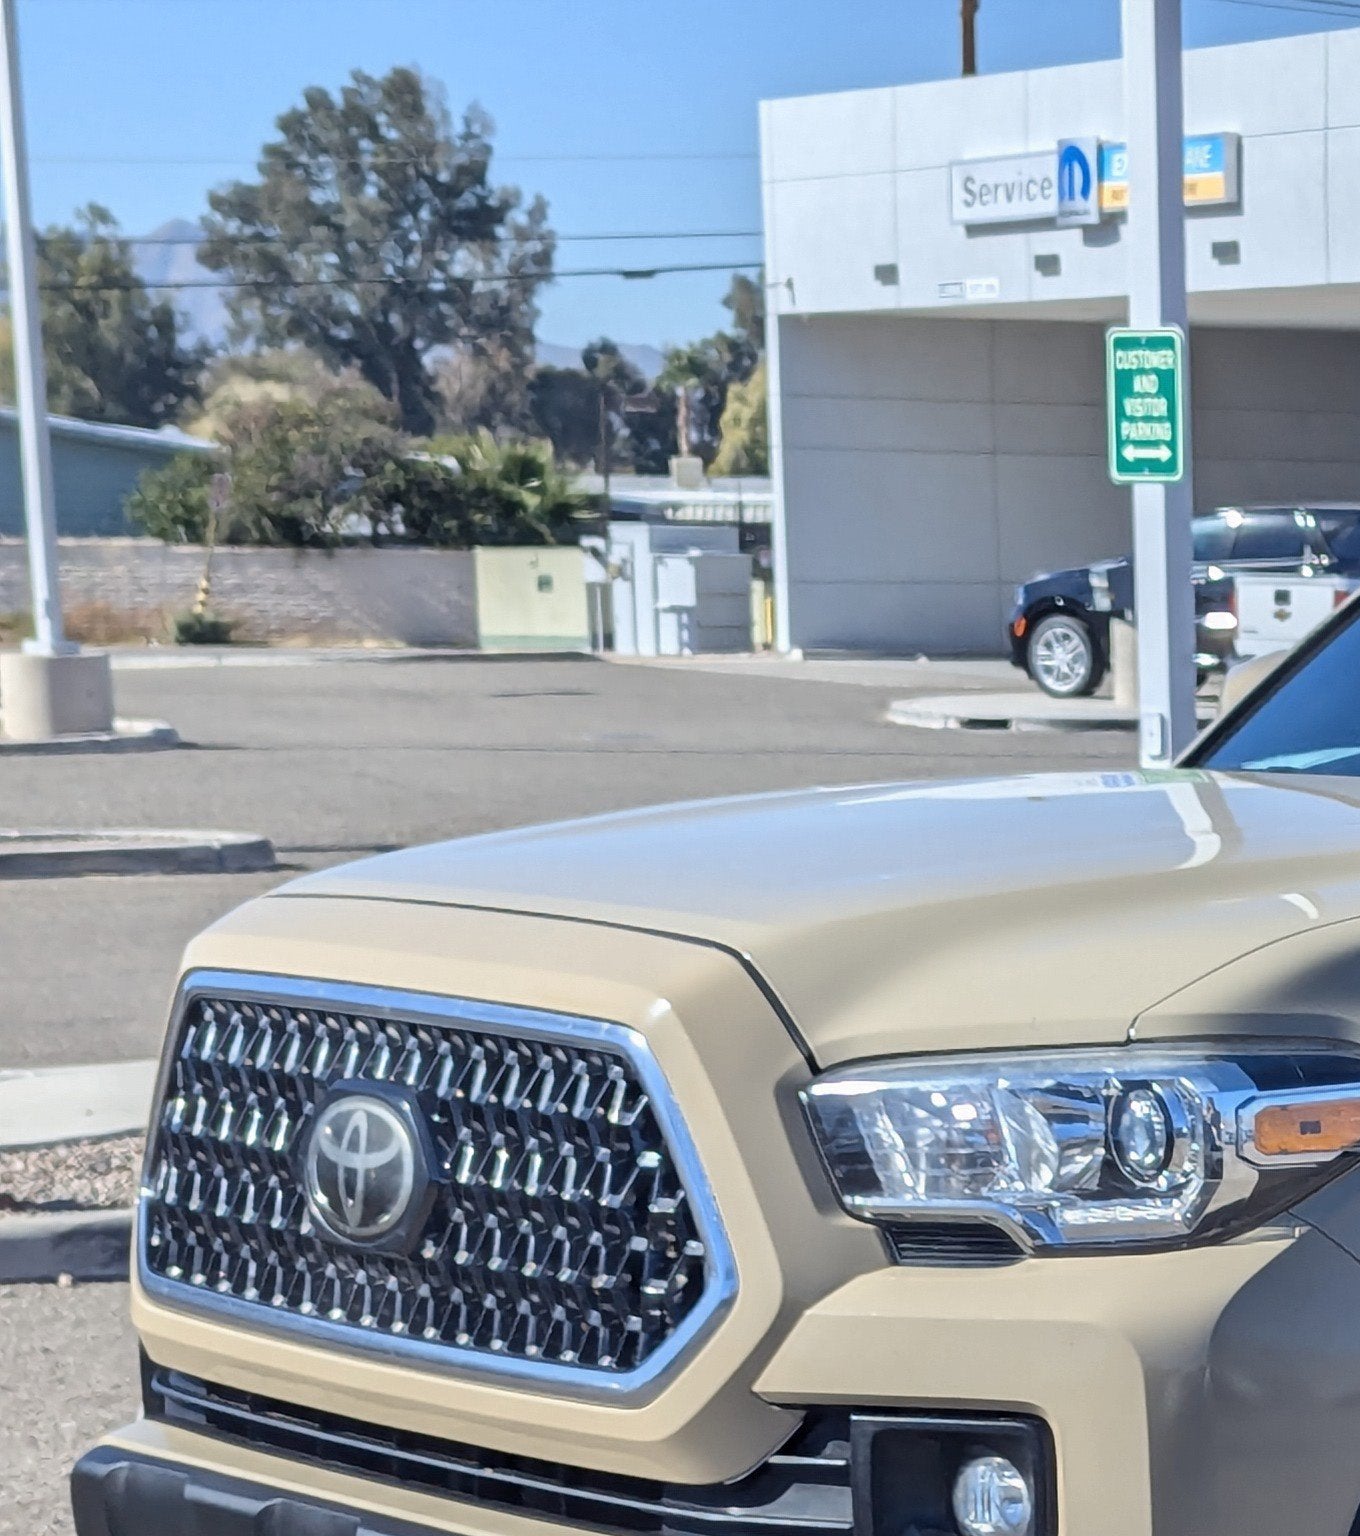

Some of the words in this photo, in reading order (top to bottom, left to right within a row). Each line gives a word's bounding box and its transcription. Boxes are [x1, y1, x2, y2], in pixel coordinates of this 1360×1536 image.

[963, 175, 1053, 207] Service
[1116, 349, 1175, 370] CUSTOMER
[1133, 373, 1159, 394] AND
[1123, 397, 1168, 417] VISITOR
[1121, 421, 1172, 441] PARKING
